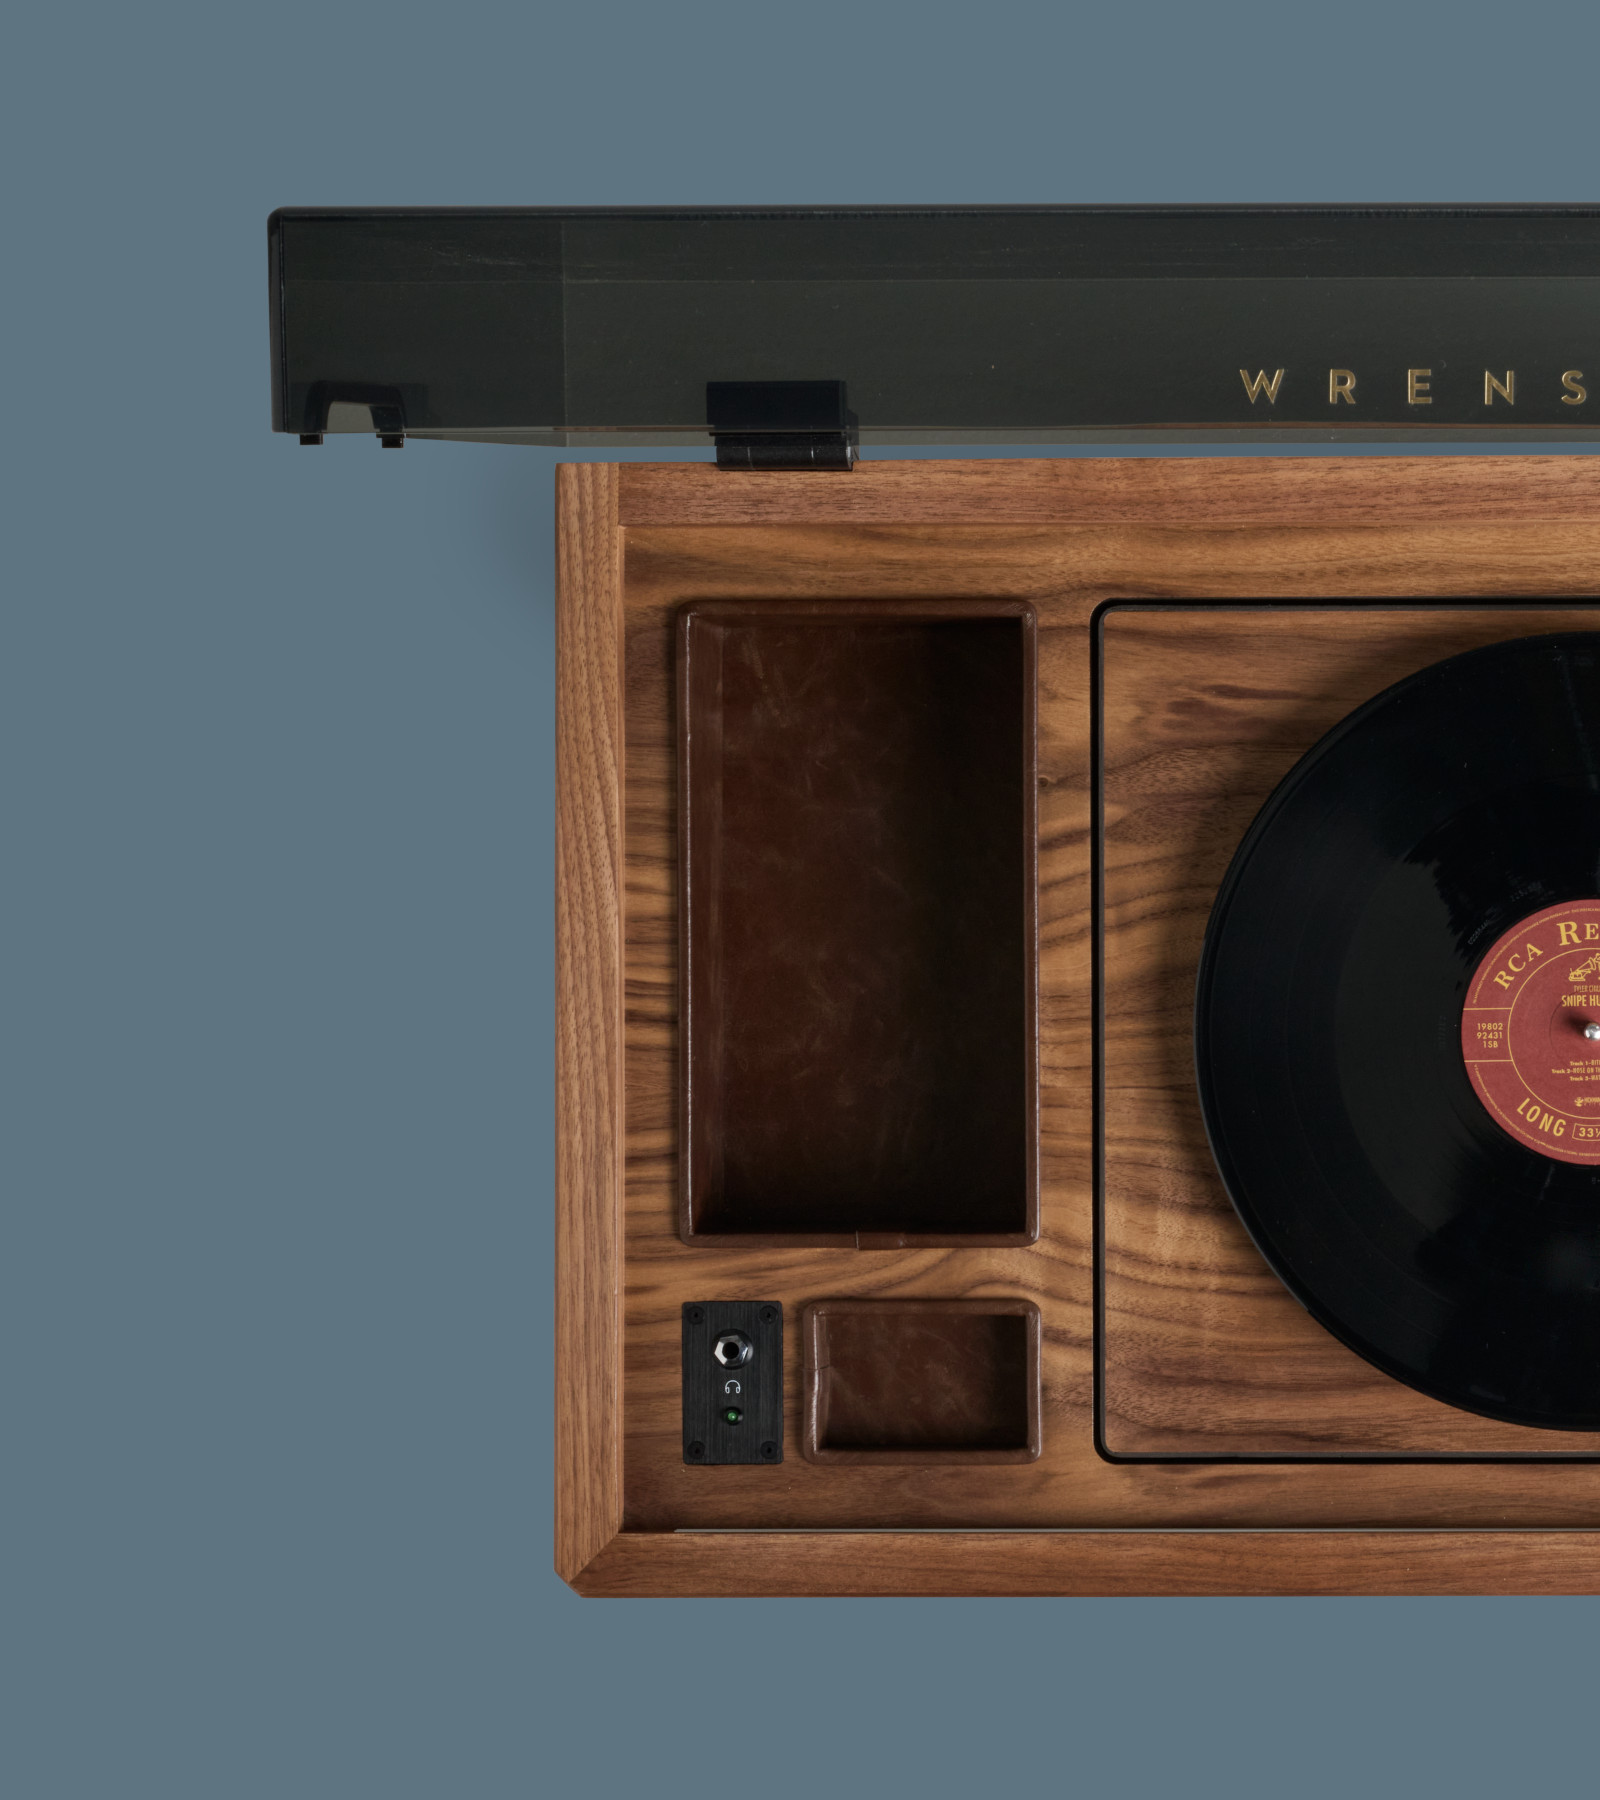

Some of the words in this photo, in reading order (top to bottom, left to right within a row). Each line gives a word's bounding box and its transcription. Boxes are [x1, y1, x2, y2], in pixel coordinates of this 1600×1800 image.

[1493, 942, 1543, 990] RCA
[1561, 994, 1587, 1007] SNIPE
[1477, 1022, 1504, 1031] 19802
[1476, 1031, 1503, 1040] 92431
[1516, 1097, 1567, 1138] LONG
